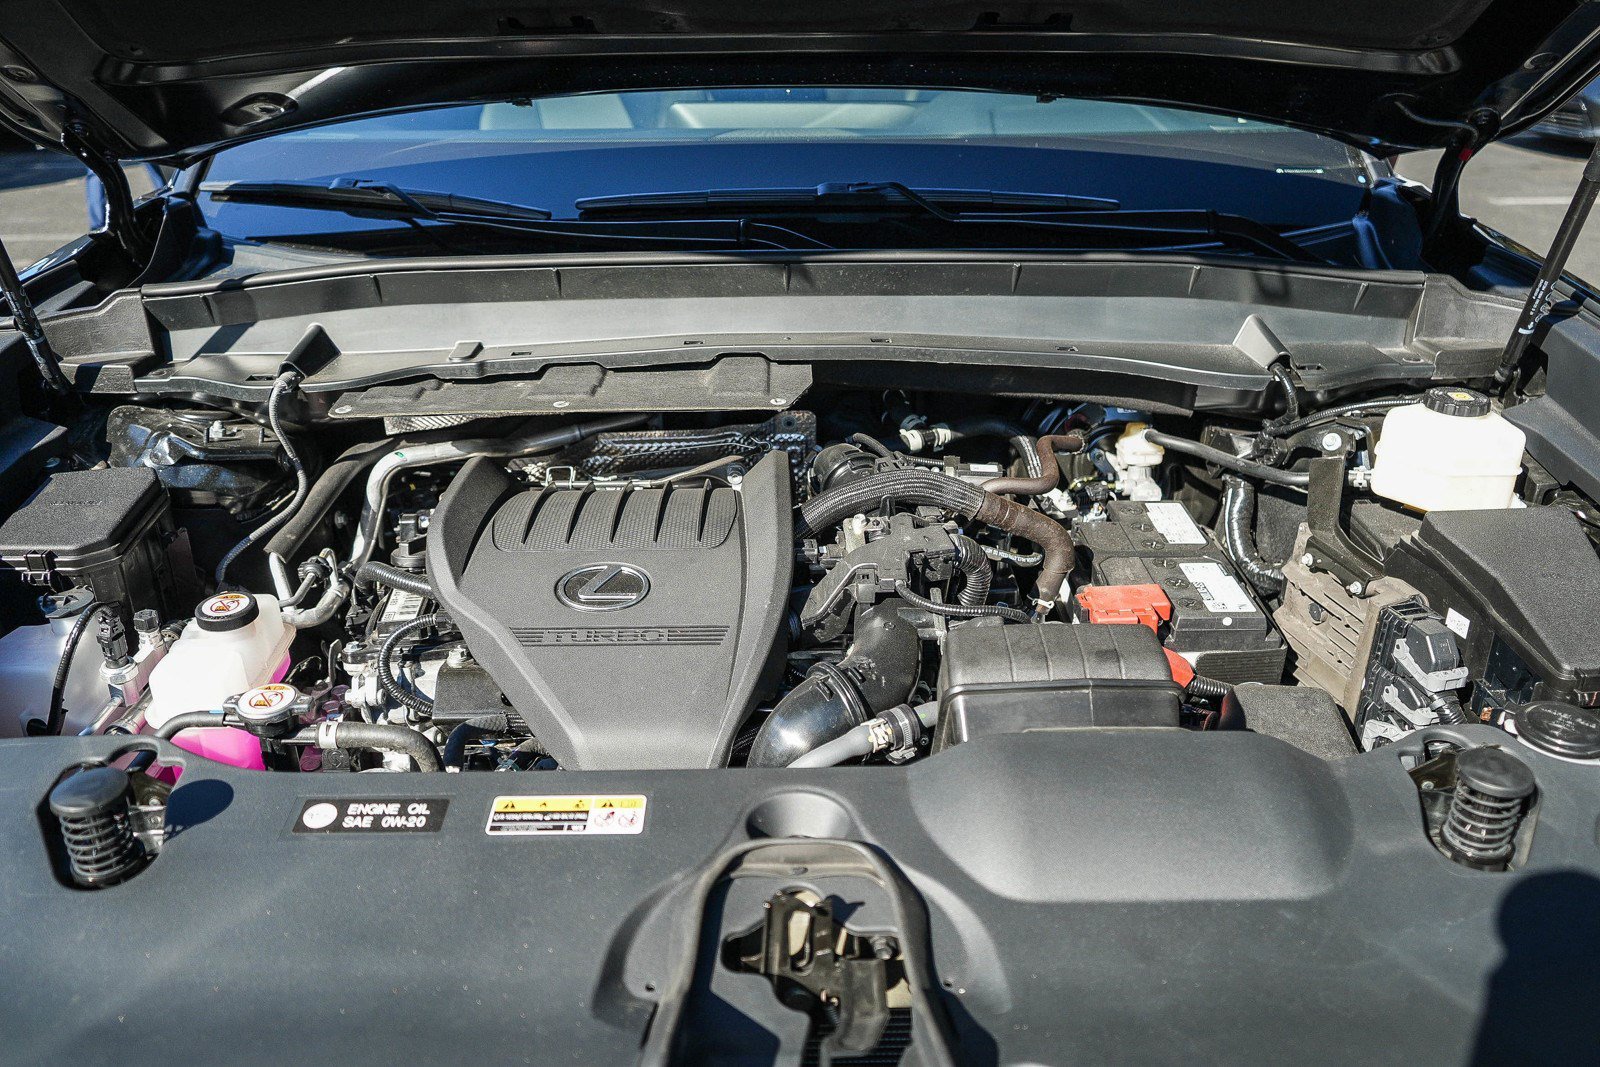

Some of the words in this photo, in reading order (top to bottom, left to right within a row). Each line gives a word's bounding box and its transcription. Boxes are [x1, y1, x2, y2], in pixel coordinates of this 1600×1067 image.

[547, 629, 664, 642] TURBO
[347, 803, 401, 815] ENGINE
[407, 803, 431, 815] OIL
[342, 815, 374, 828] SAE
[381, 815, 427, 828] 0W-20
